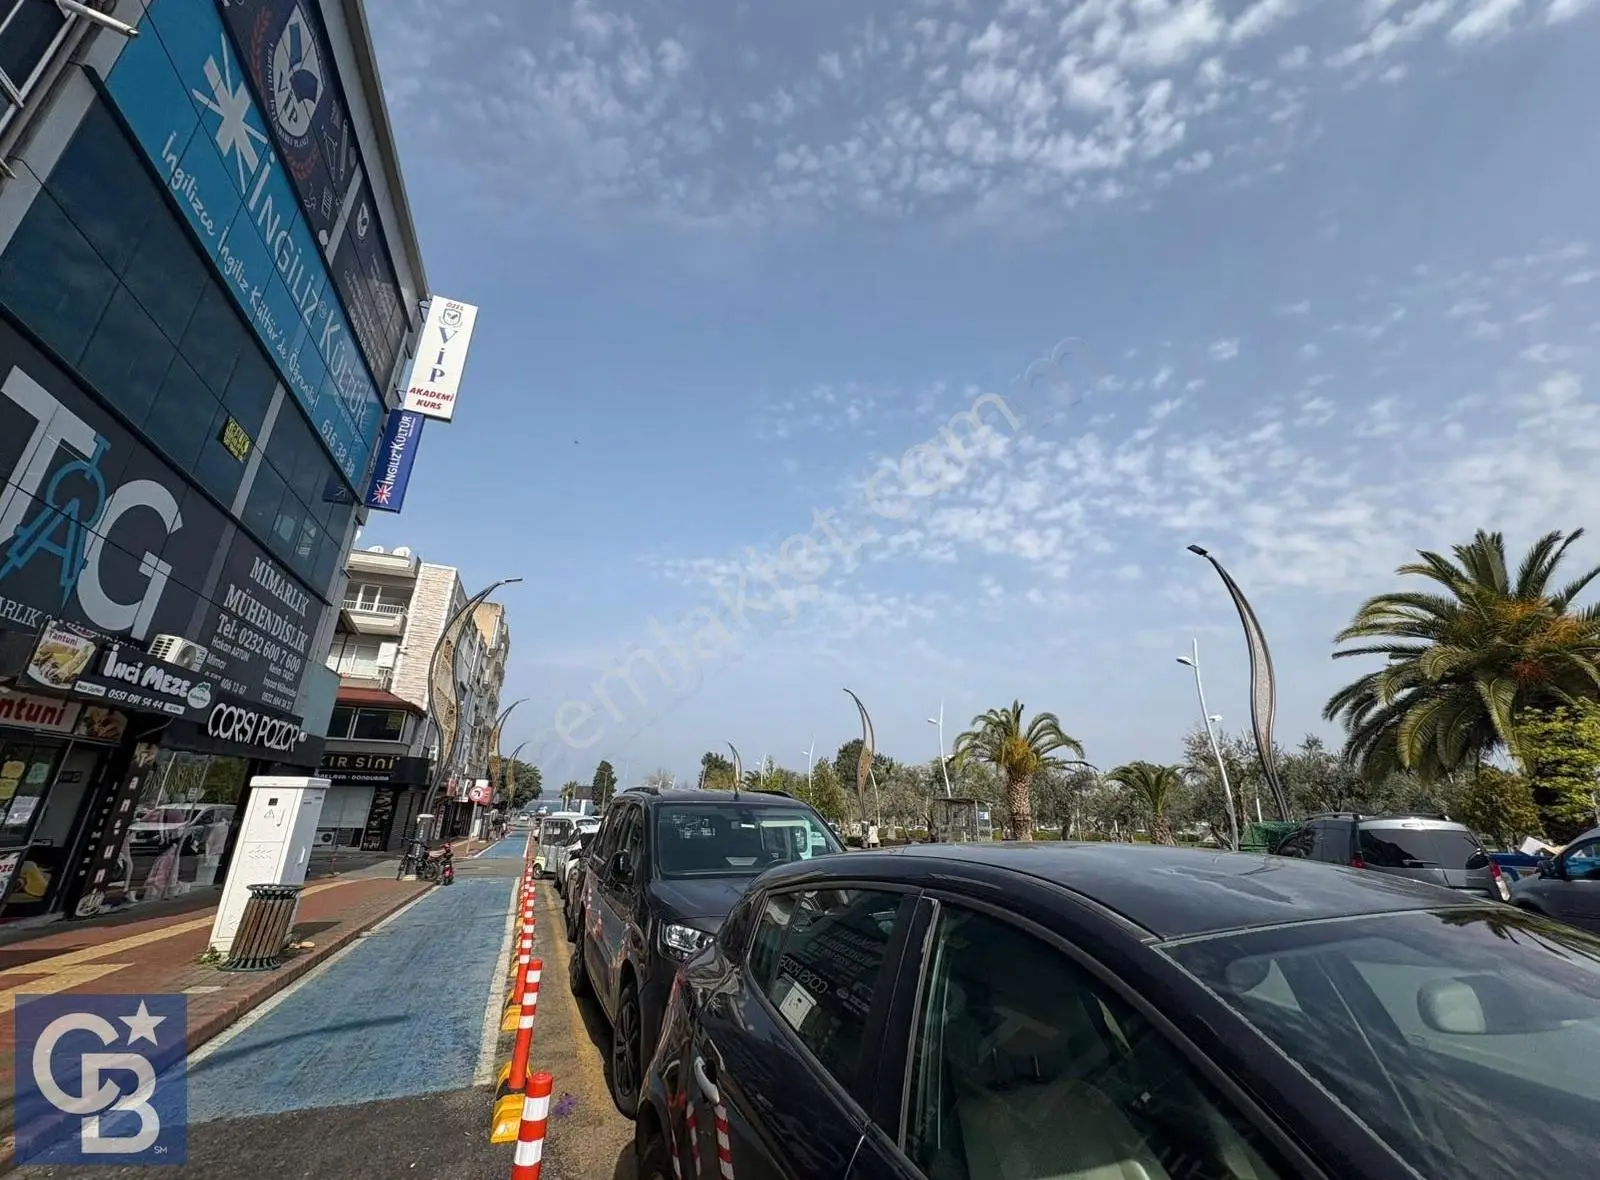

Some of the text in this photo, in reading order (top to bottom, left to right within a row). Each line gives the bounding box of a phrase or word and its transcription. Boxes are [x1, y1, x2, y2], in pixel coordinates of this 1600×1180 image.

[162, 130, 215, 236] İngilizce
[408, 387, 455, 402] AKADEMİ
[416, 398, 442, 410] KURS
[321, 419, 338, 448] 616
[335, 442, 347, 464] 38
[250, 556, 310, 617] MİMARLIK
[217, 613, 301, 674] Tel: 0232 600 7 600
[223, 583, 309, 654] MÜHENDİSLİK
[108, 688, 127, 701] 0551
